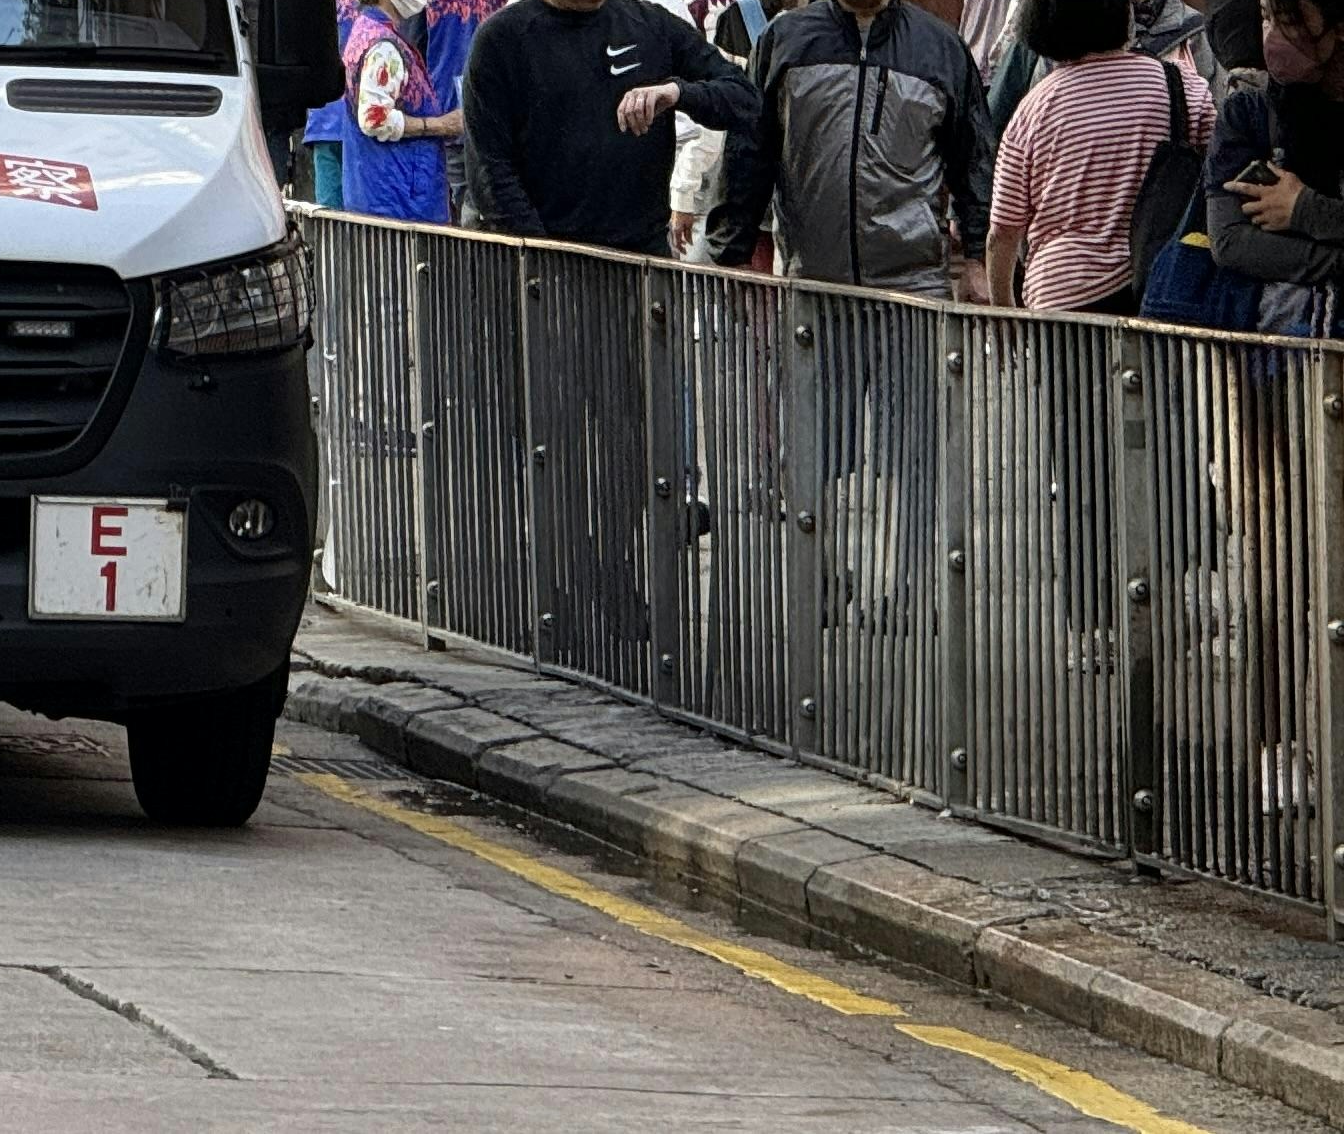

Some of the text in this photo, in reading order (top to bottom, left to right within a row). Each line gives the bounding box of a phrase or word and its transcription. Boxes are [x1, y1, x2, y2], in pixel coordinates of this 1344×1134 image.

[4, 159, 83, 205] 察
[90, 506, 128, 556] E
[99, 561, 118, 612] 1
